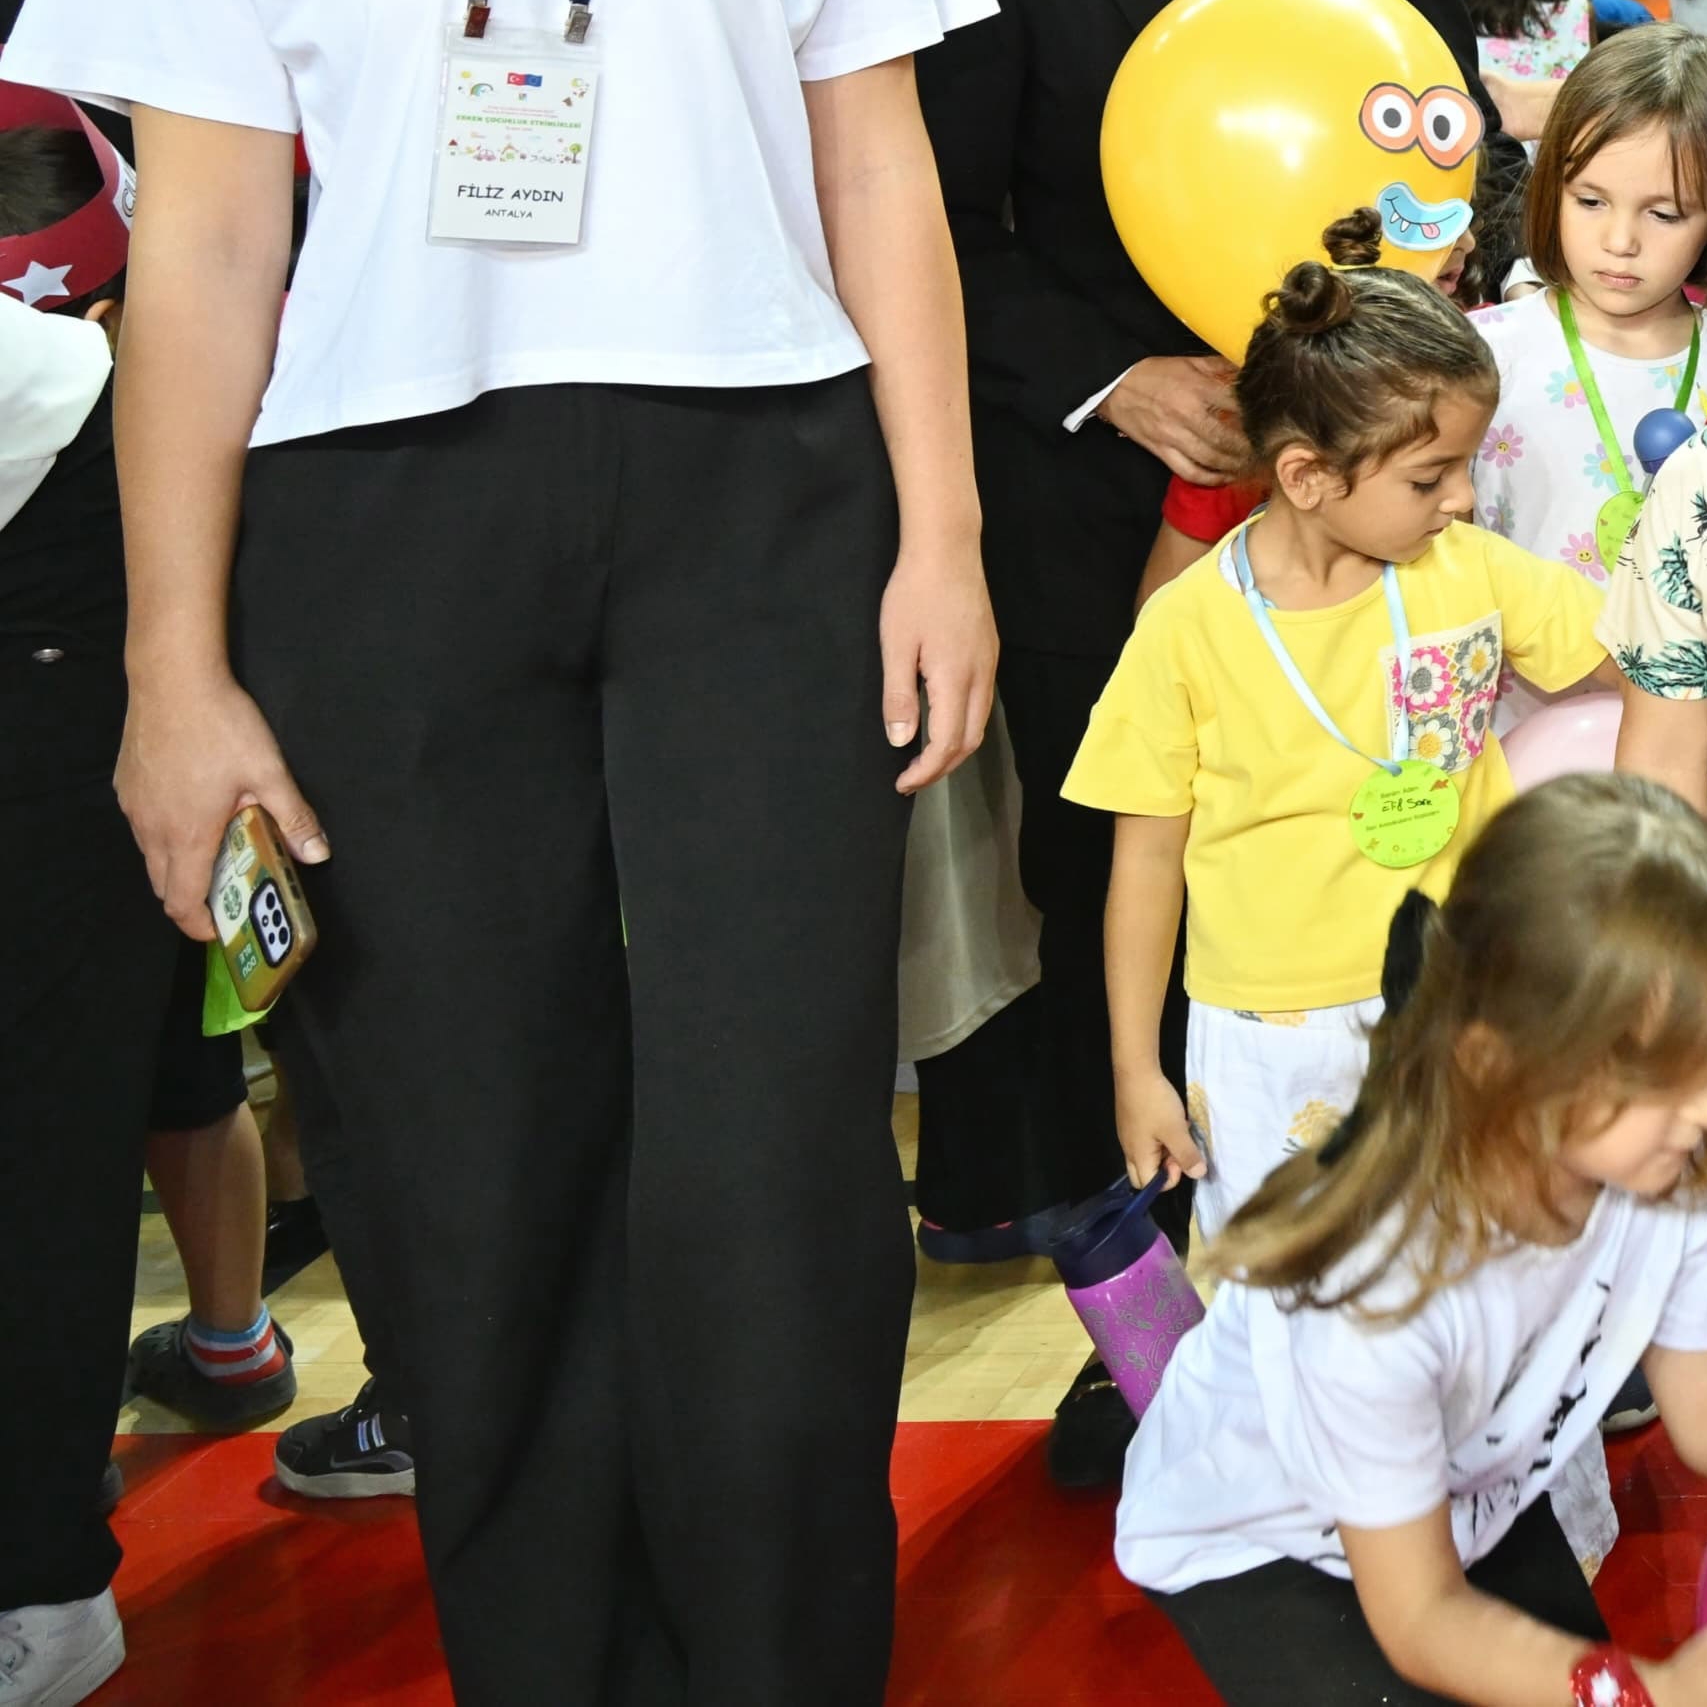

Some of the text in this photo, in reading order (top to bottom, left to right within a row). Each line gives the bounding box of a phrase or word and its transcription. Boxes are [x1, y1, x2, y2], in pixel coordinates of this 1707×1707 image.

[457, 183, 564, 203] FİLİZ AYDIN
[484, 208, 533, 219] ANTALYA
